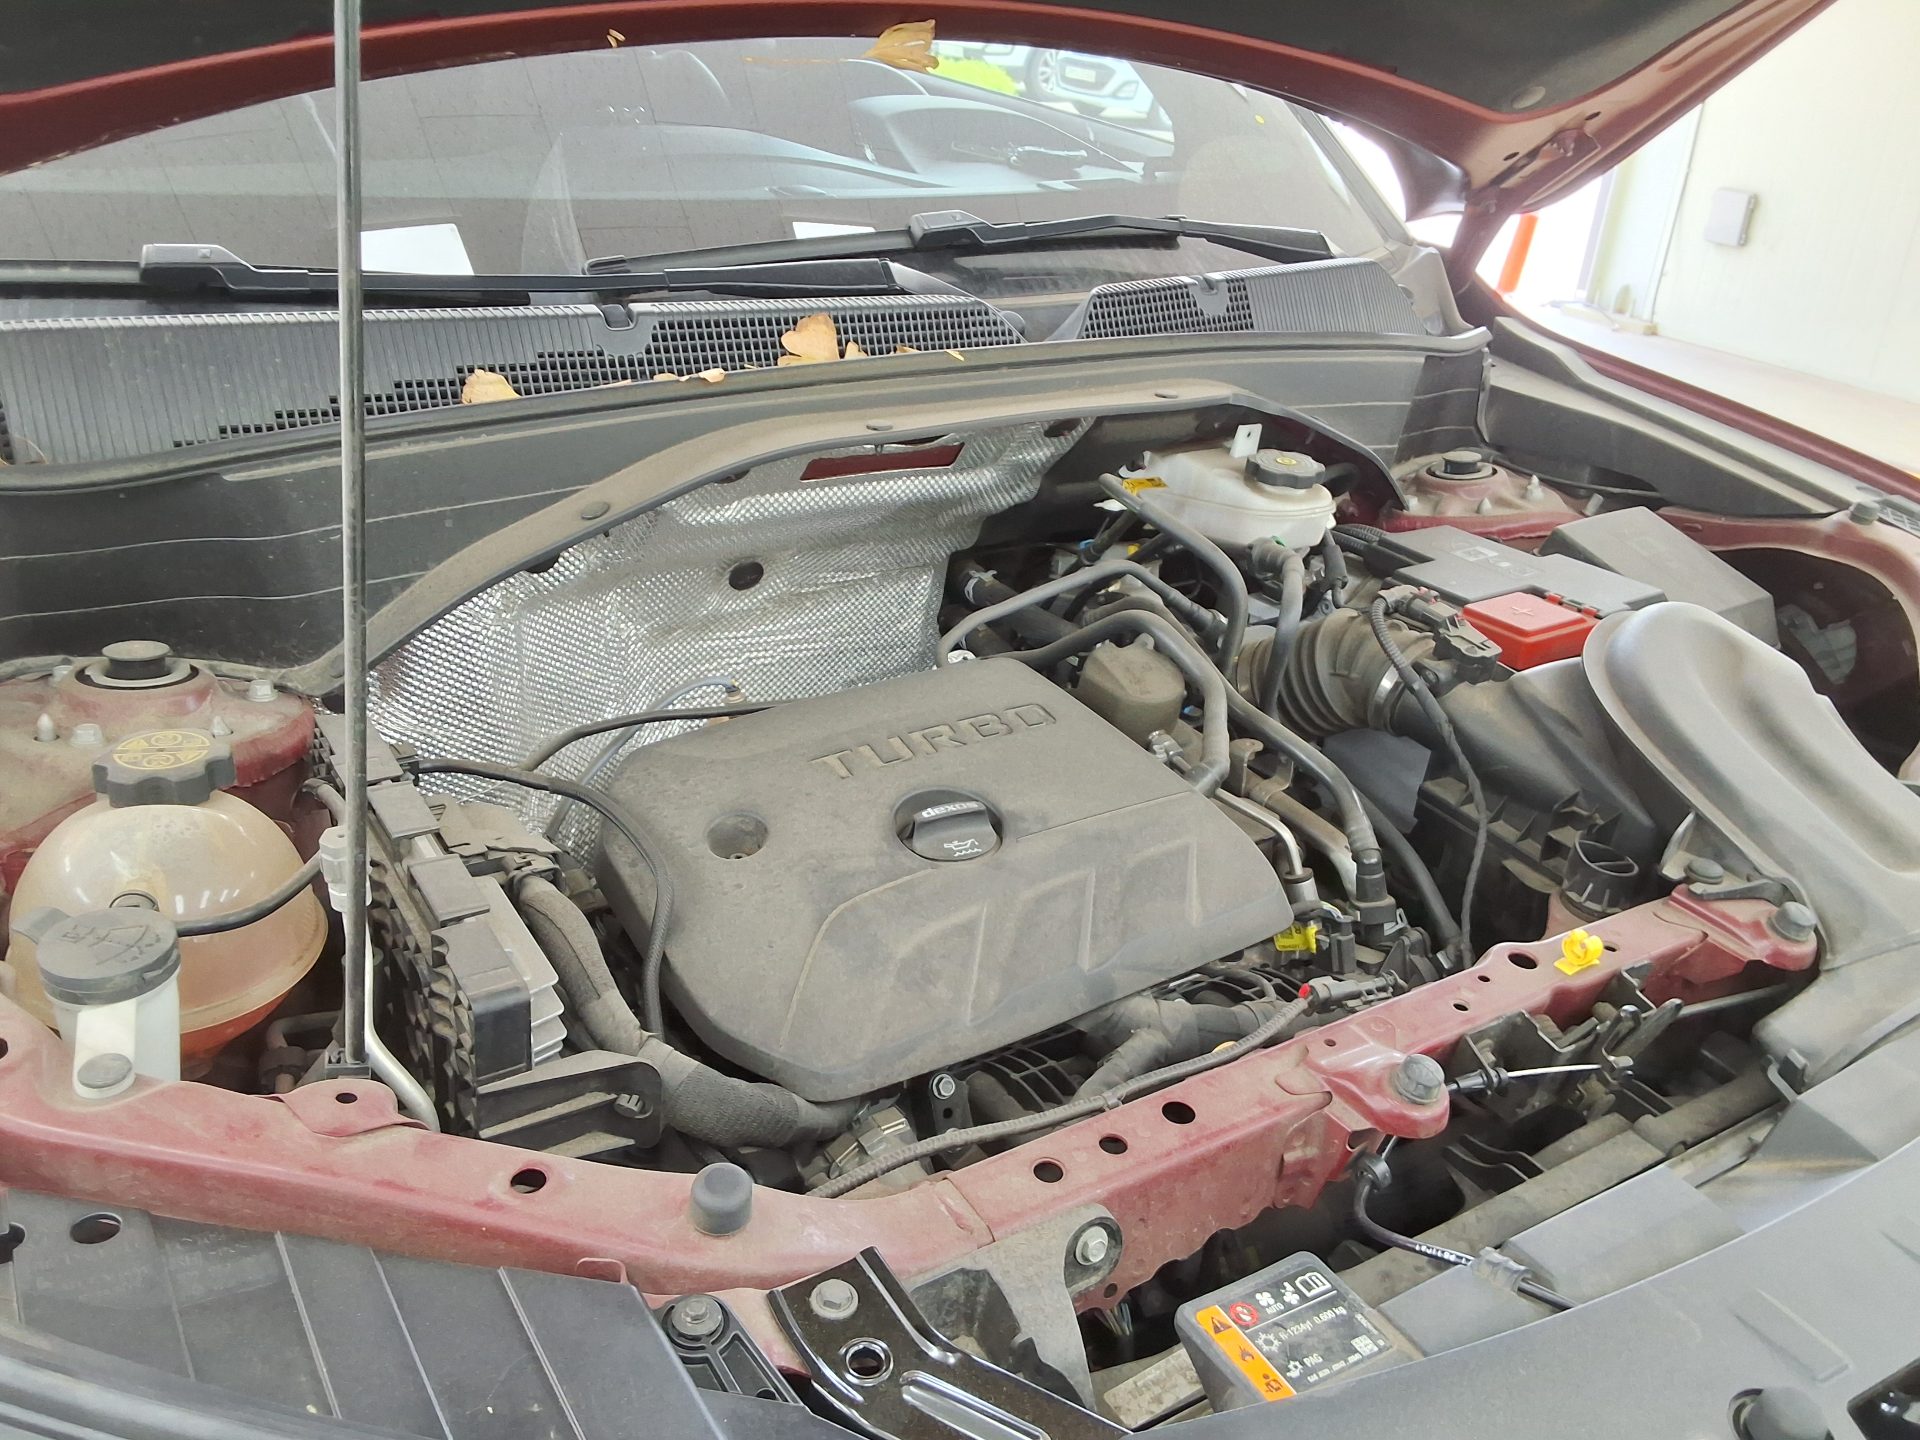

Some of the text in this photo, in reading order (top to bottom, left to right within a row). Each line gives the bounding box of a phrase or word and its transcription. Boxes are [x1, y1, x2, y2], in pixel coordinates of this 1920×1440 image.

[808, 703, 1057, 779] TURBO
[921, 801, 979, 818] dexos
[1265, 1302, 1285, 1315] AUTO
[1332, 1306, 1348, 1318] kg
[1303, 1353, 1323, 1368] PAG
